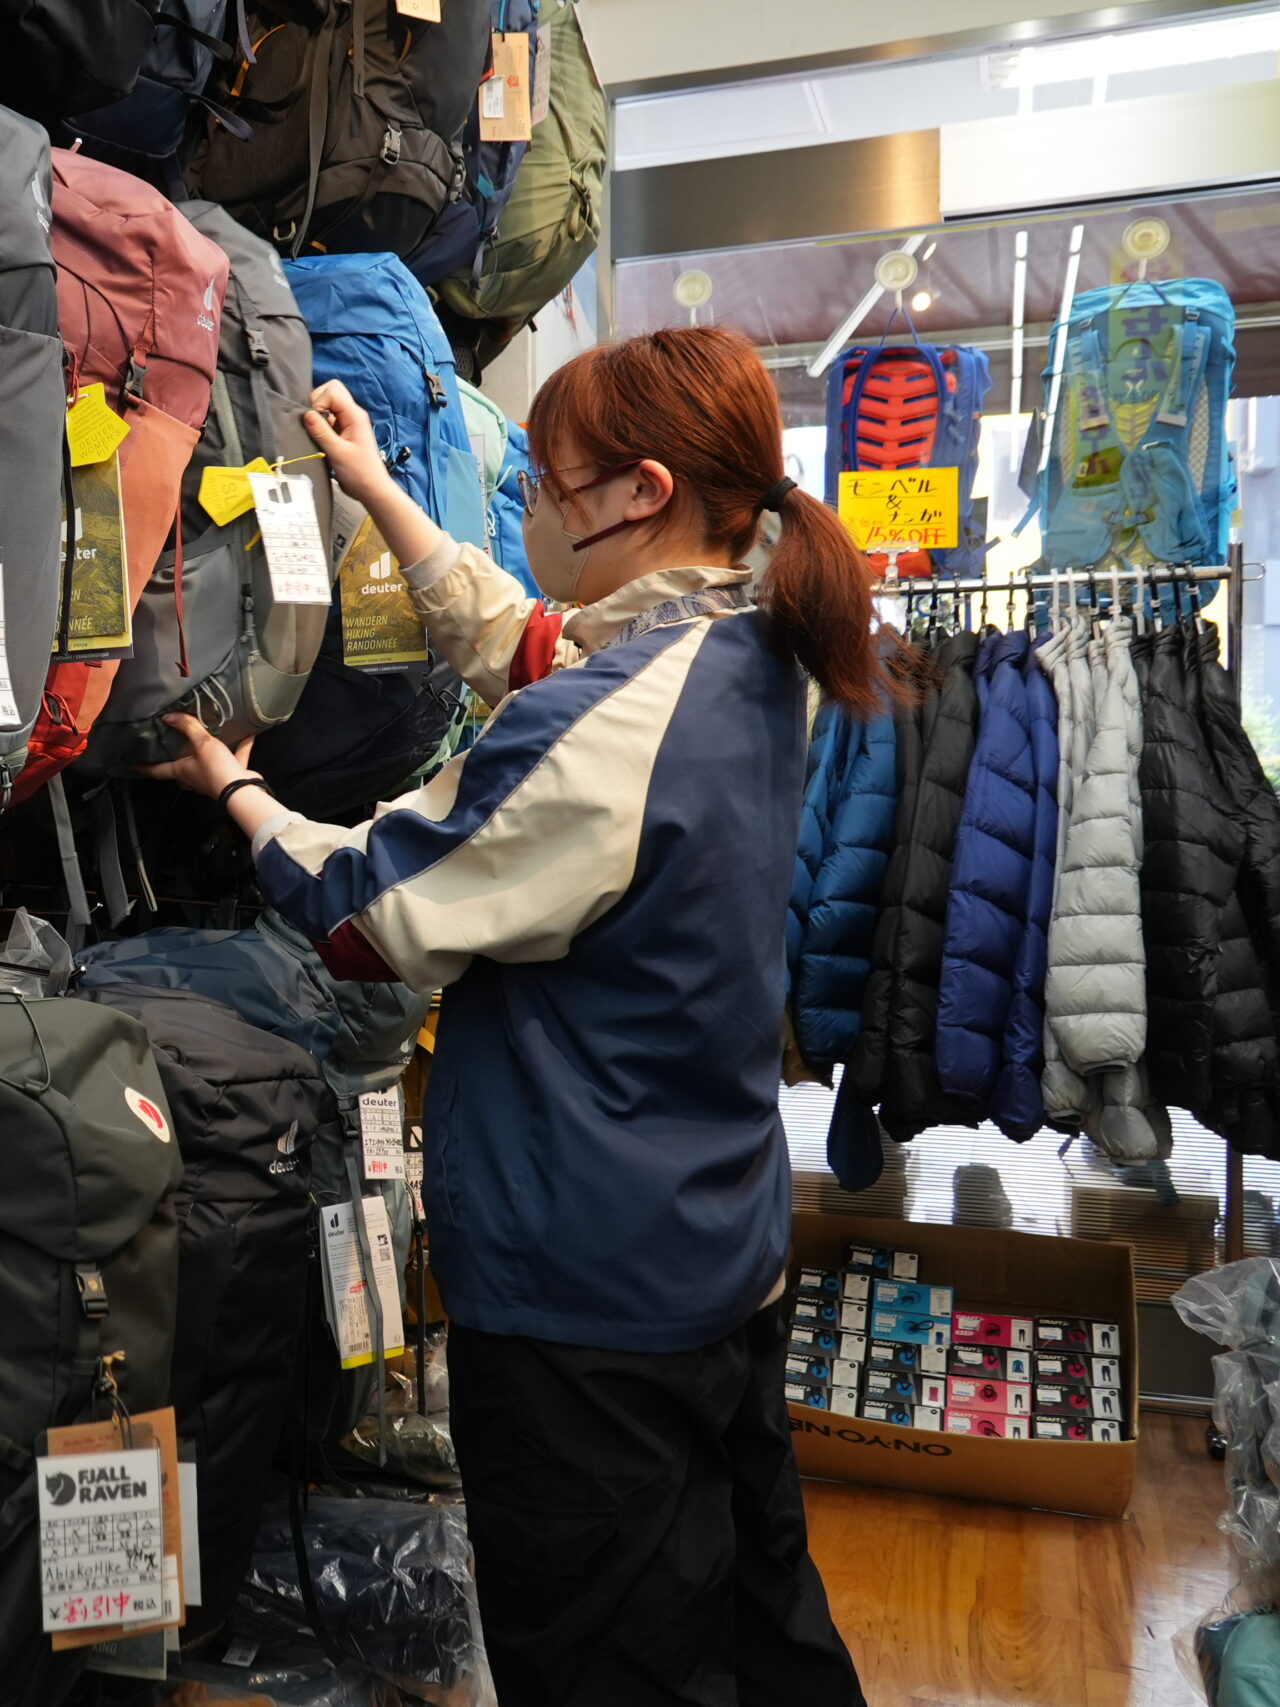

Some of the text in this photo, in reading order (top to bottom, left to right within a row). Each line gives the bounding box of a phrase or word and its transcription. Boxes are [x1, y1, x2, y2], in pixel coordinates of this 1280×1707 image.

[79, 424, 115, 449] DEUTER
[97, 445, 110, 457] FIT
[847, 477, 938, 497] モンベル
[886, 494, 902, 509] &
[361, 582, 403, 595] deuter
[346, 616, 388, 628] WANDERN
[346, 628, 375, 640] HIKING
[346, 636, 399, 652] RANDONNÉE
[362, 1097, 397, 1107] deuter
[328, 1229, 345, 1238] deuter
[792, 1324, 814, 1332] CRAFT
[787, 1353, 809, 1361] CRAFT
[865, 1400, 888, 1408] CRAFT
[49, 1607, 60, 1620] ¥
